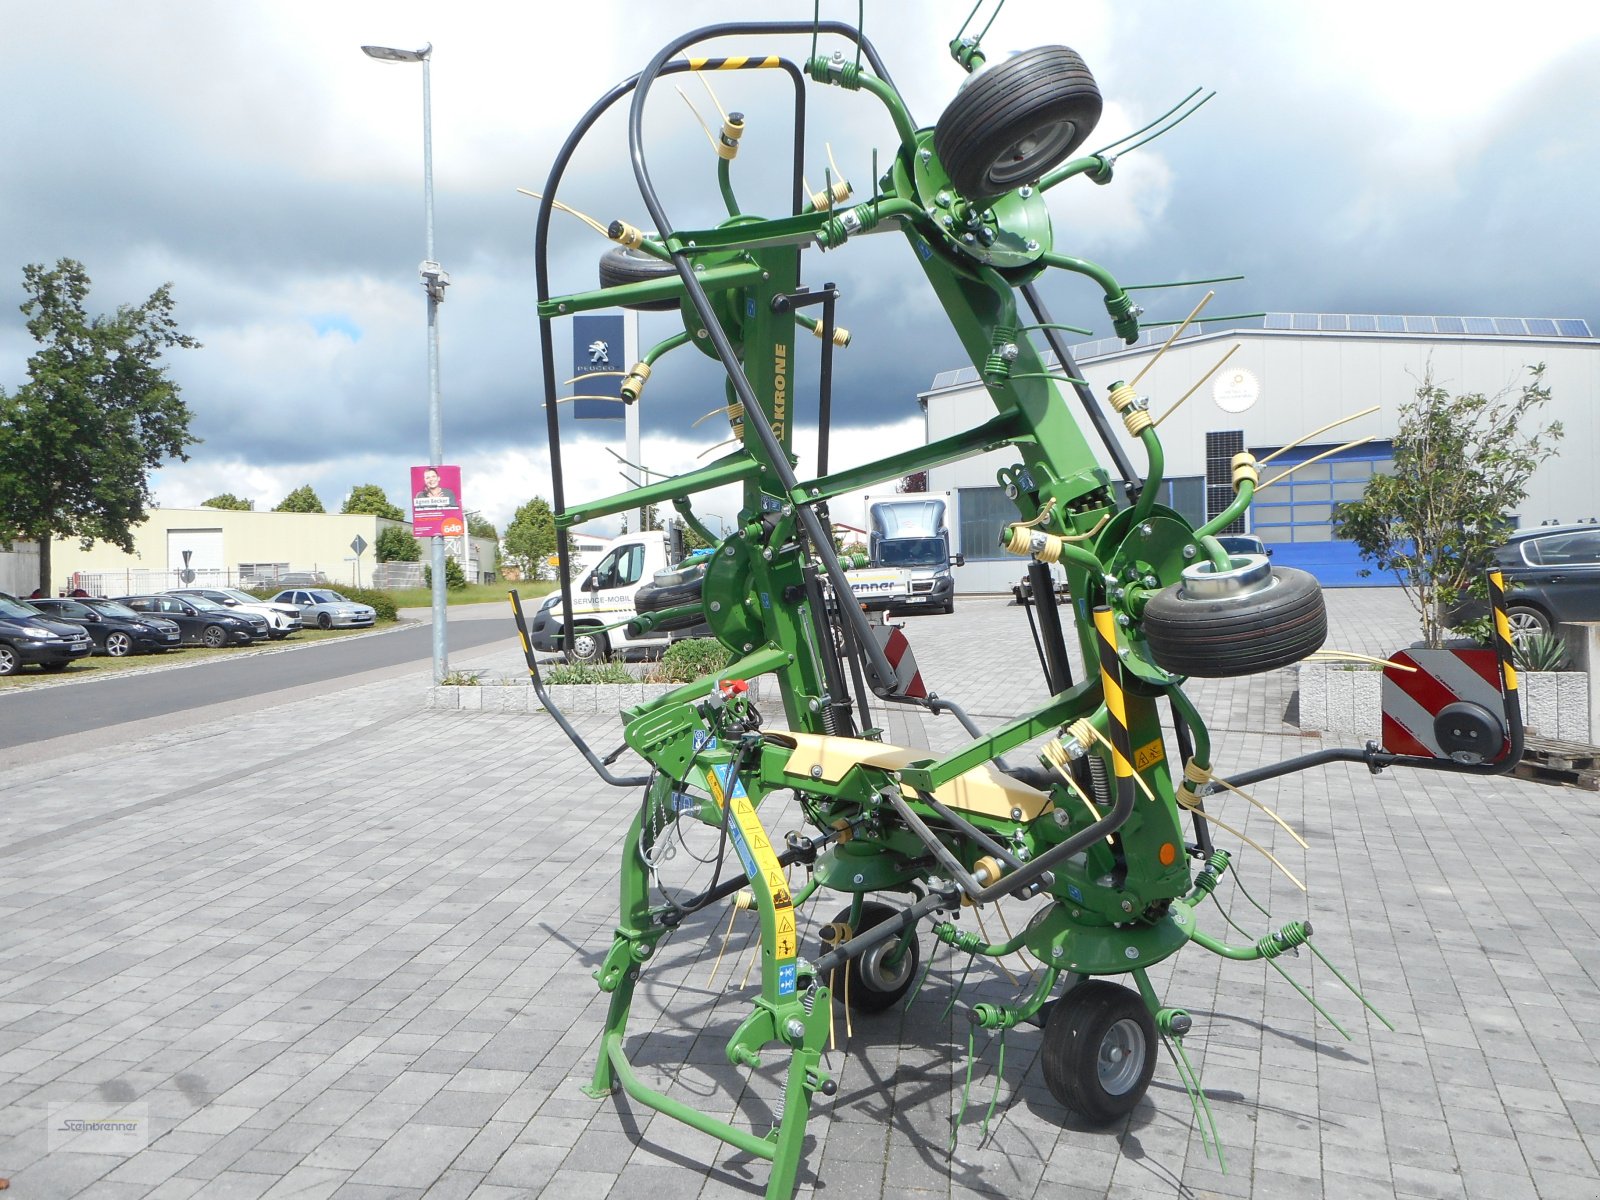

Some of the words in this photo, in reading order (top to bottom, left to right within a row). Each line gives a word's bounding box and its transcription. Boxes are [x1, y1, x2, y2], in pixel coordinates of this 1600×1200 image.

[774, 343, 786, 420] KRONE
[443, 523, 462, 533] ödp
[850, 581, 895, 593] enner
[573, 595, 632, 606] SERVICE-MOBIL
